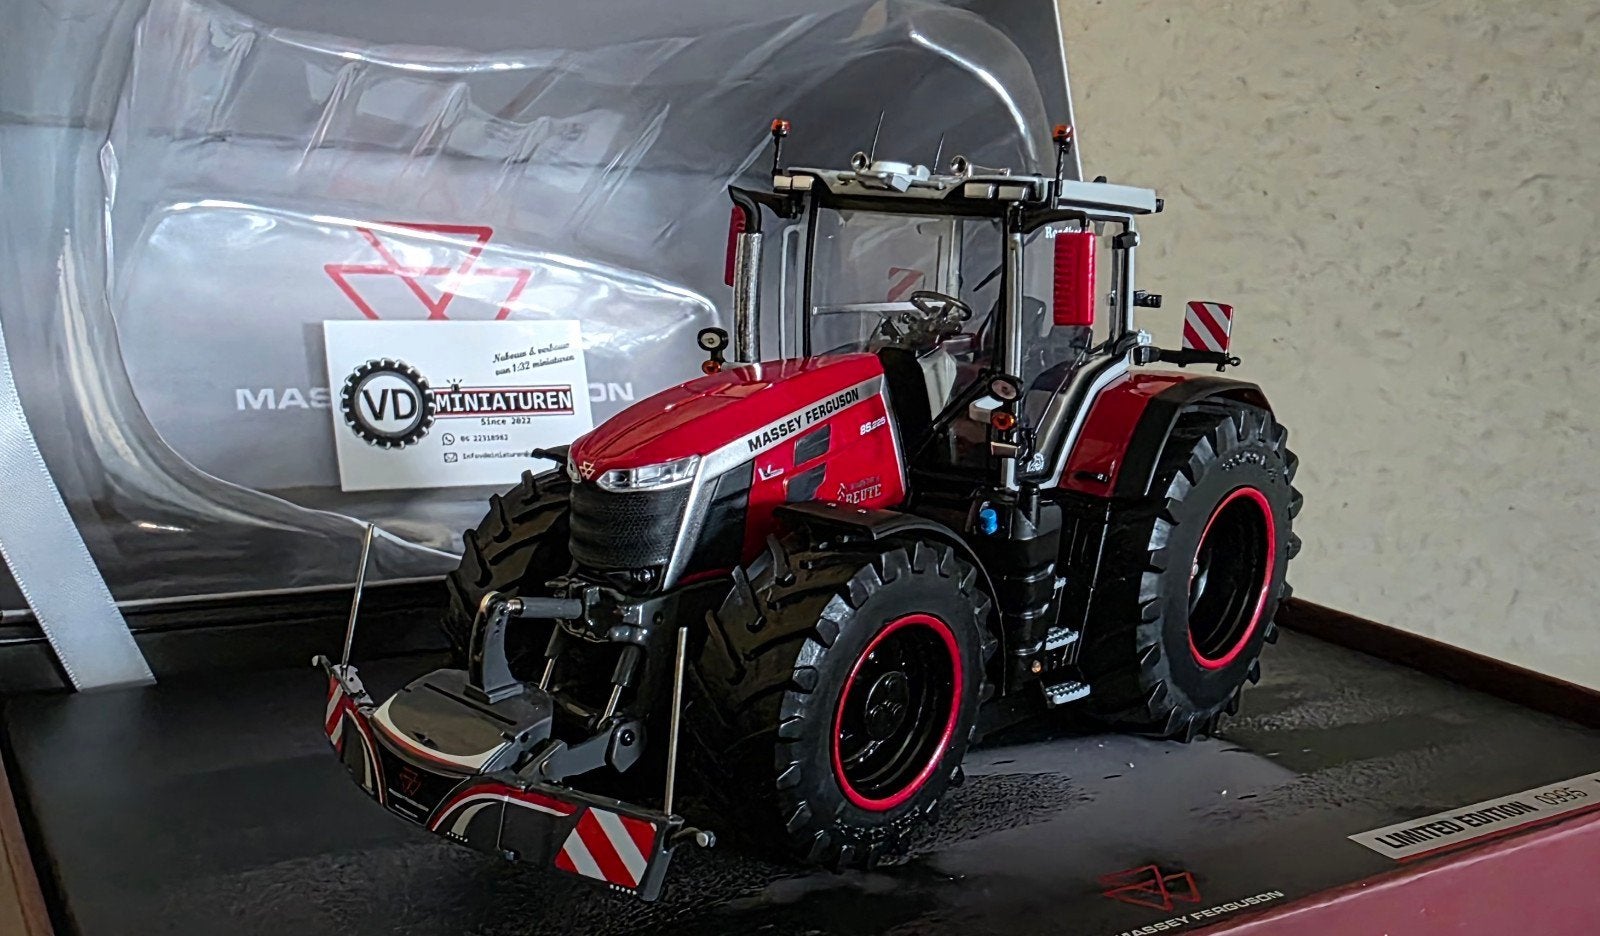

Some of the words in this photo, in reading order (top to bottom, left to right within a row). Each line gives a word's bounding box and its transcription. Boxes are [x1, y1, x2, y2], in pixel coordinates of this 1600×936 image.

[529, 346, 536, 356] &
[533, 354, 575, 368] miniaturen
[236, 387, 330, 410] MAS
[363, 388, 418, 421] VD
[434, 391, 572, 412] MINIATUREN
[748, 415, 803, 452] MASSEY
[806, 388, 860, 425] FERGUSON
[1375, 820, 1466, 849] LIMITED
[1454, 801, 1540, 828] EDITION
[1190, 890, 1285, 921] FERGUSON
